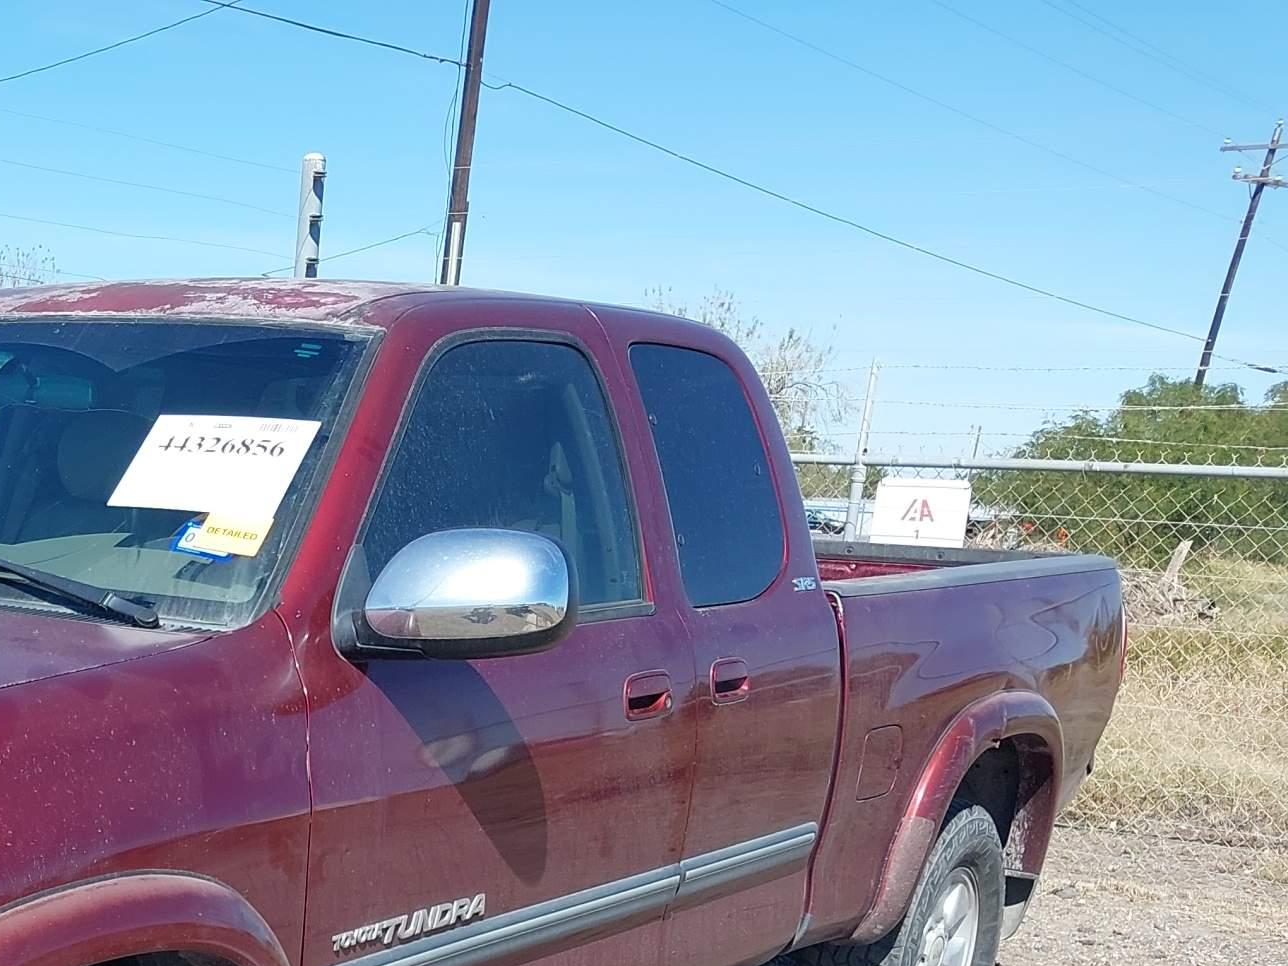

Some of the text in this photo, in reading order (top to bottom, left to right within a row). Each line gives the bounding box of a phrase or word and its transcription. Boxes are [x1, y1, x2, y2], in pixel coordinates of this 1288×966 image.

[158, 436, 287, 456] 44326856
[206, 526, 258, 541] DETAILED
[331, 892, 486, 952] TOYOTA TUNDRA
